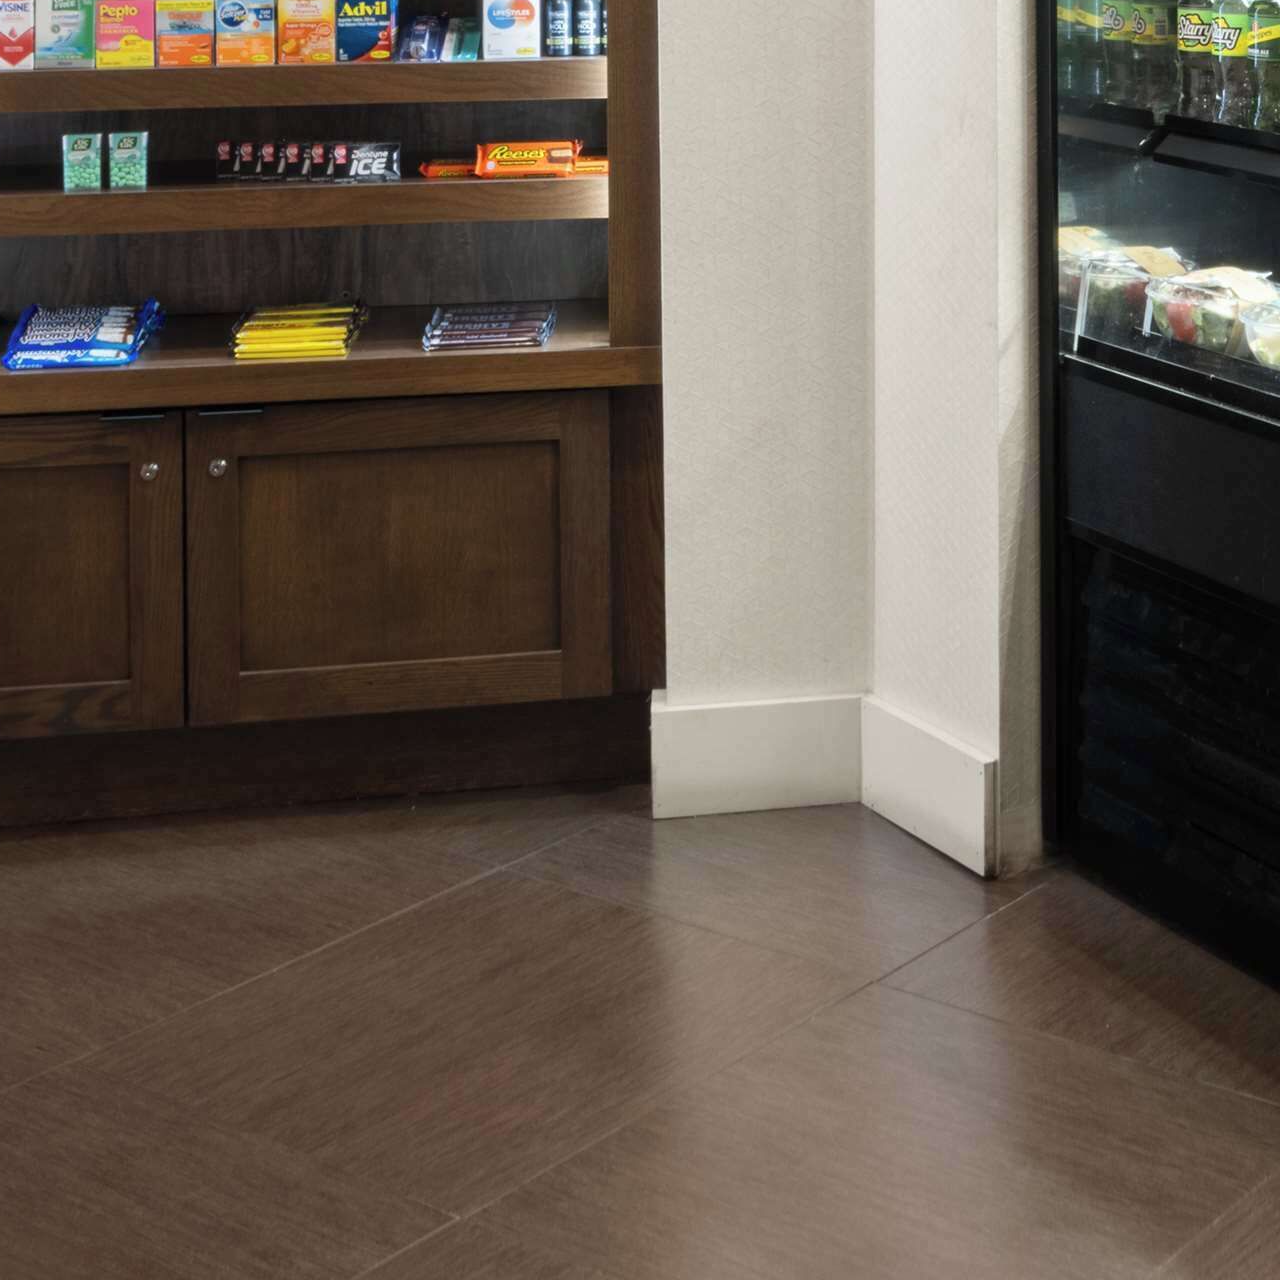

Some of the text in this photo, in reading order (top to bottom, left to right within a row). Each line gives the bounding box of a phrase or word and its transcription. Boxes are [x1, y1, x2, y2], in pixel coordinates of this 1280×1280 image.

[100, 4, 139, 19] Pepto
[339, 1, 388, 17] Advil
[1178, 16, 1212, 45] Starry
[351, 149, 389, 160] Dentyne
[487, 146, 546, 160] Reese's
[349, 158, 387, 177] ICE
